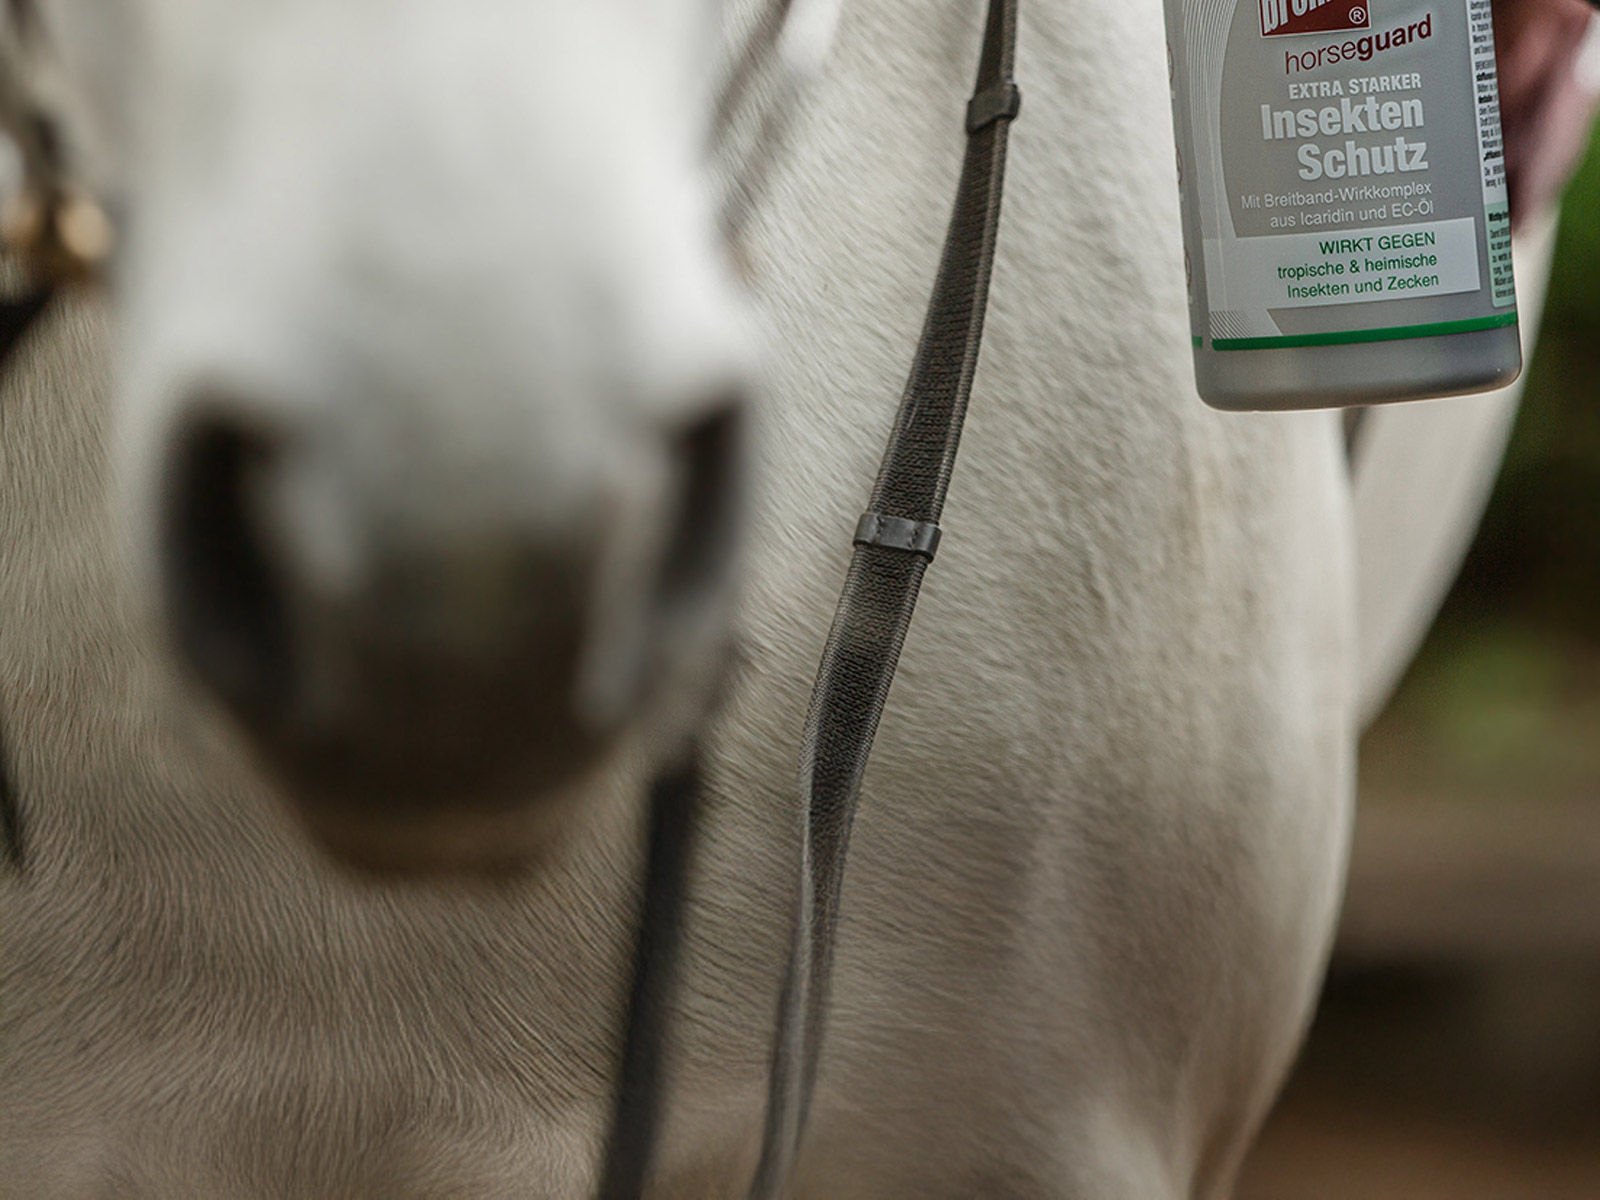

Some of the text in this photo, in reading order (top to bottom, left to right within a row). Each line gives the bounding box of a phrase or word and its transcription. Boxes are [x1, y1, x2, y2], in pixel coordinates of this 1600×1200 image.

[1284, 13, 1432, 75] horseguard
[1289, 73, 1421, 99] EXTRA STARKER
[1260, 96, 1424, 140] Insekten
[1297, 137, 1429, 181] Schutz
[1241, 181, 1432, 209] Mit Breitband-Wirkkomplex
[1270, 215, 1297, 228] aus
[1300, 206, 1355, 226] Icaridin
[1359, 205, 1387, 221] und
[1319, 232, 1435, 255] WIRKT GEGEN
[1277, 253, 1438, 280] tropische & heimische
[1287, 274, 1439, 299] Insekten und Zecken
